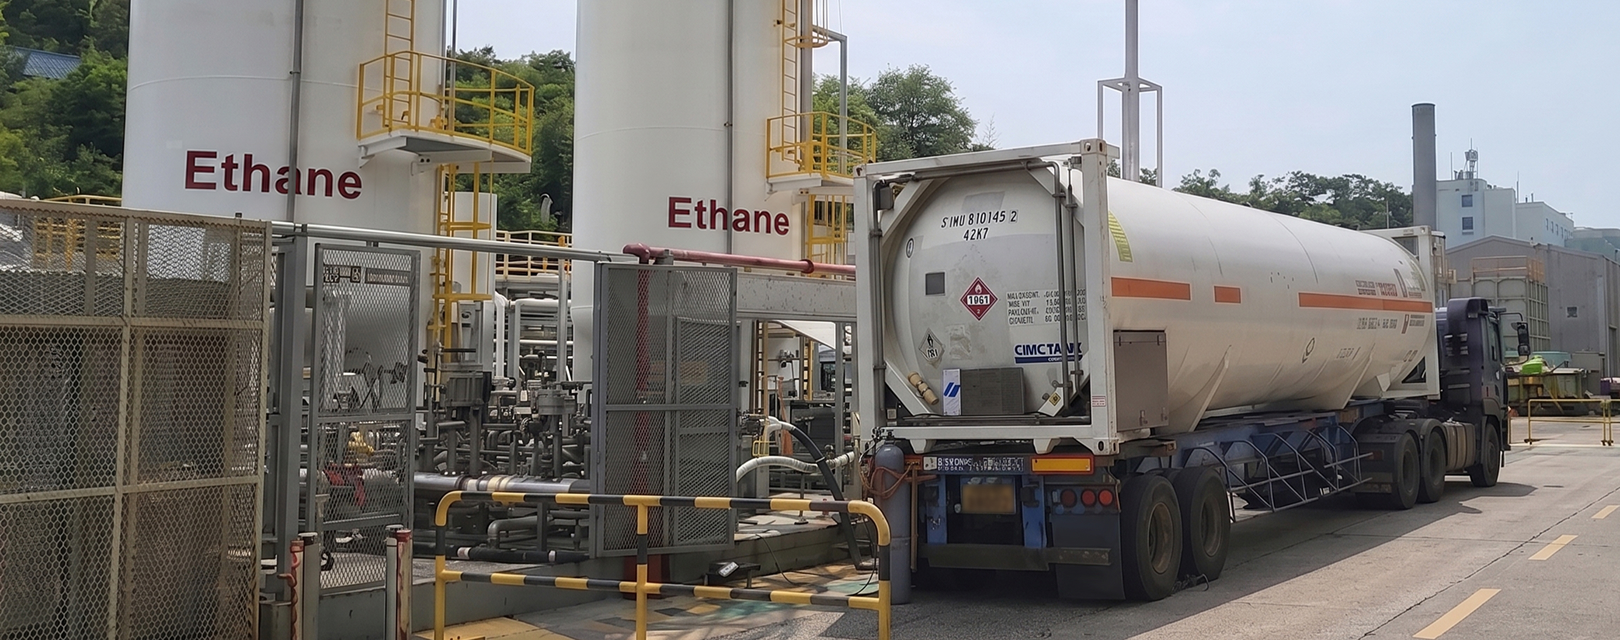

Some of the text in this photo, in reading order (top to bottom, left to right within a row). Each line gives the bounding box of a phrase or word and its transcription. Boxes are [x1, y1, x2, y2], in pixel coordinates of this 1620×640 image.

[185, 150, 362, 200] Ethane
[668, 196, 790, 236] Ethane
[968, 210, 1006, 226] 810145
[1010, 210, 1017, 222] 2
[963, 227, 989, 241] 42K7
[1014, 343, 1046, 356] CIMC
